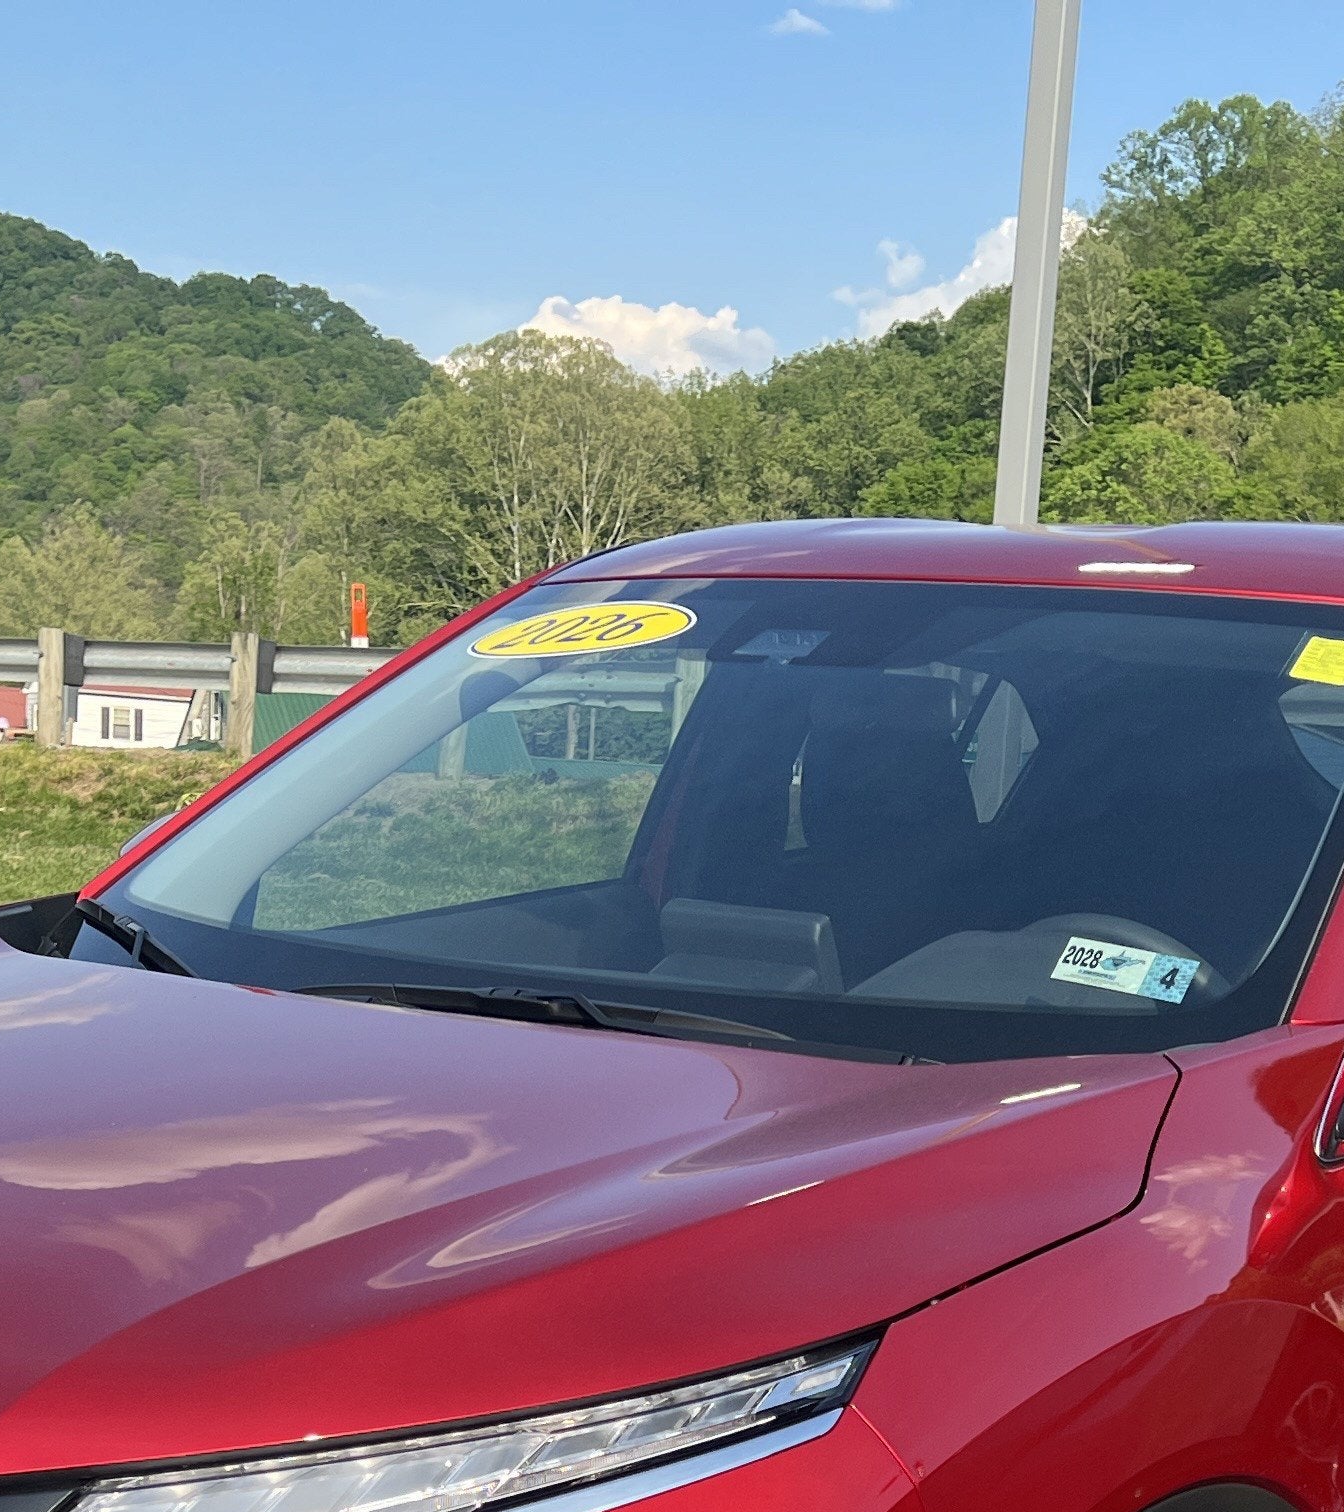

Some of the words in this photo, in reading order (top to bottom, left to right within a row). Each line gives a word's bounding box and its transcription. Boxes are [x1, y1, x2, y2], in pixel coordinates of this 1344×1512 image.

[488, 612, 670, 651] 2026
[1061, 945, 1104, 969] 2028
[1159, 967, 1180, 990] 4
